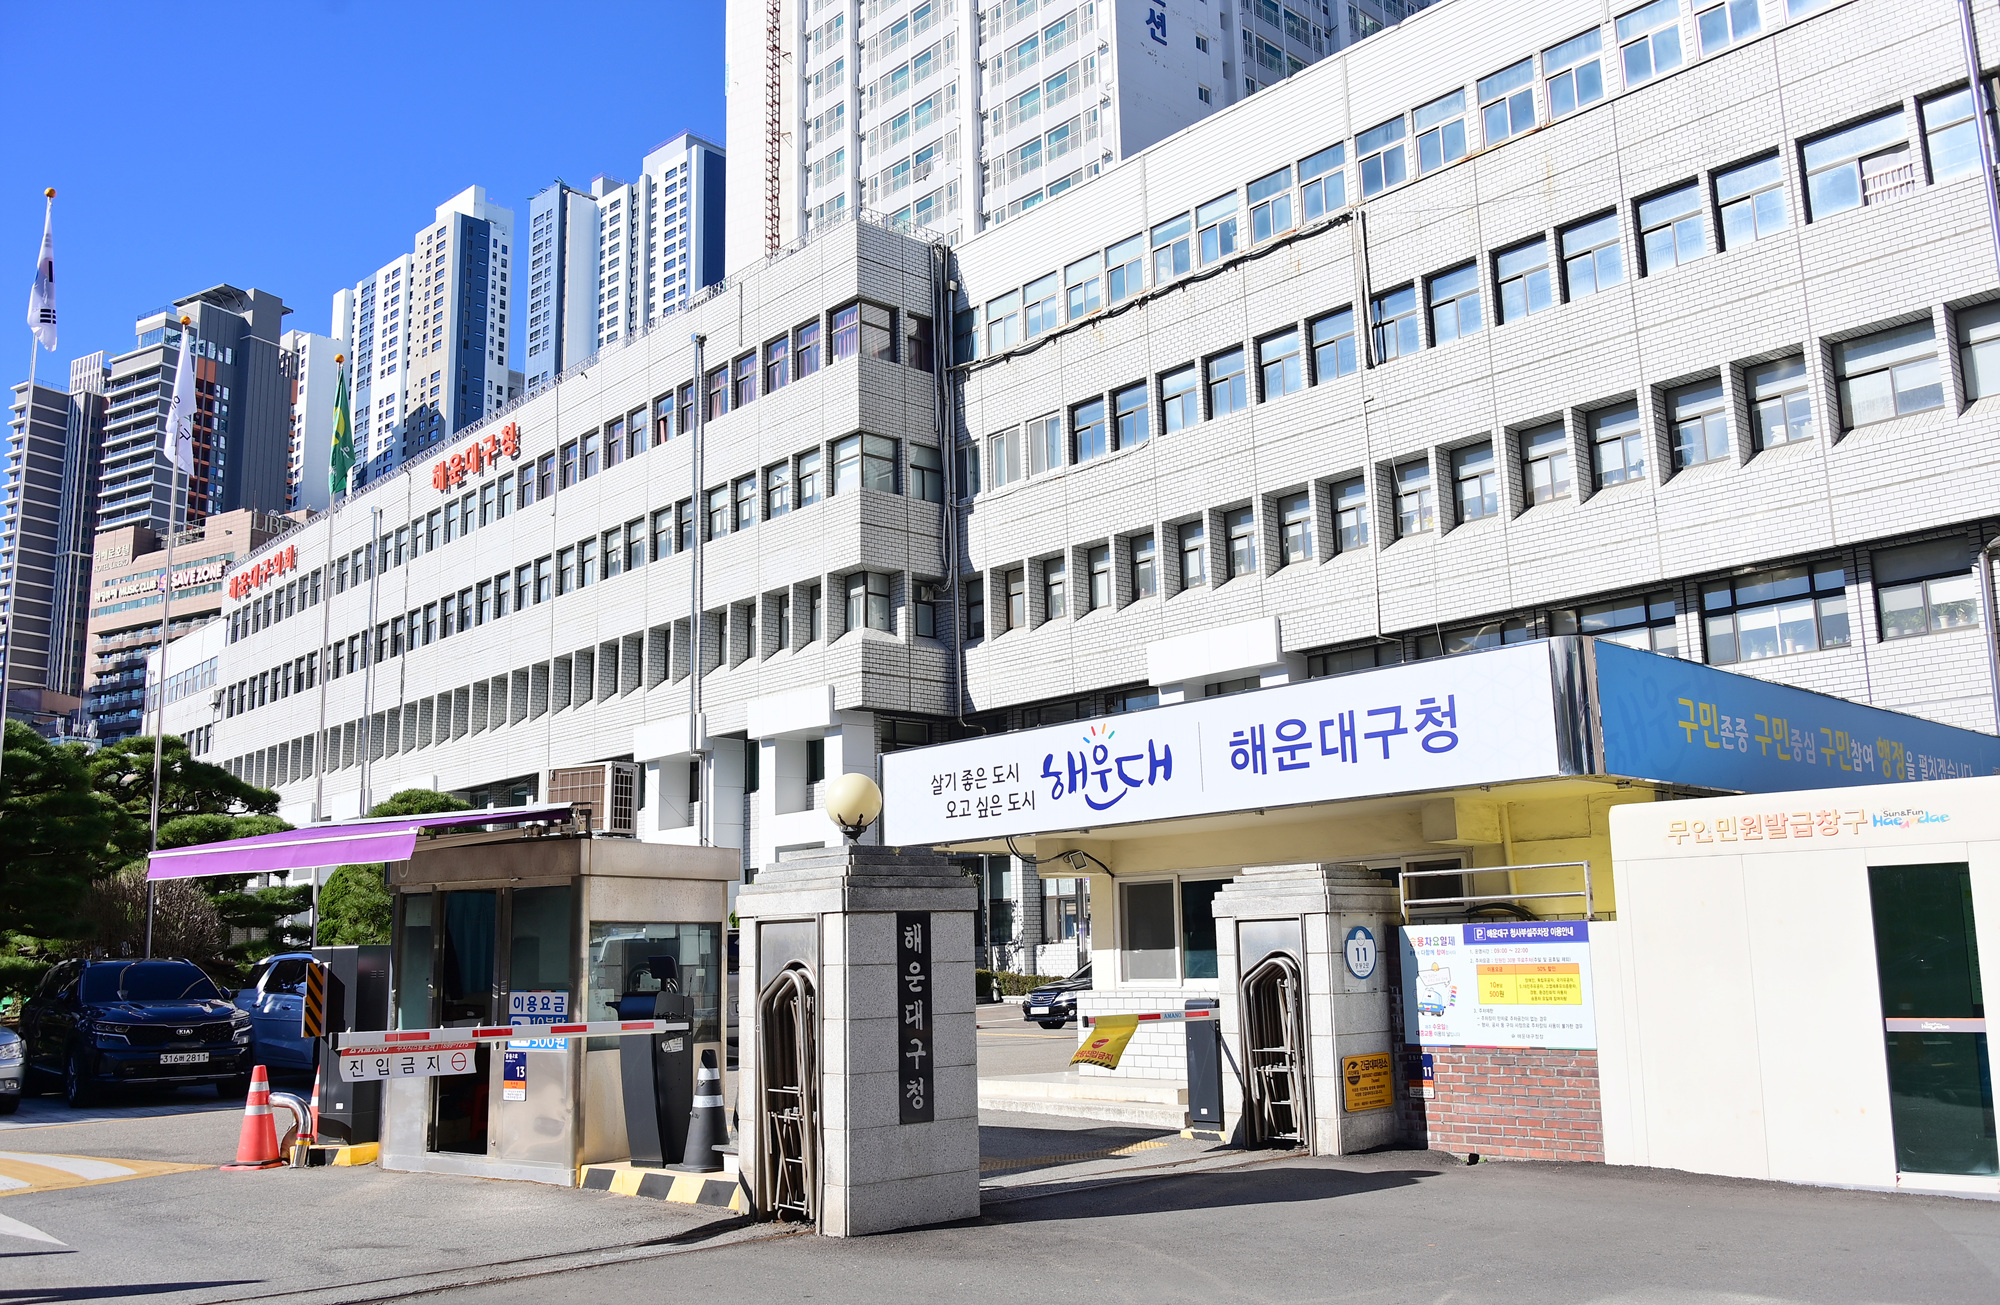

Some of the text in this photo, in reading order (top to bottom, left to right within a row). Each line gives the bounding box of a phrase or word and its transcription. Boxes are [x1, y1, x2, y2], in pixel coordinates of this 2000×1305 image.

[1145, 0, 1167, 46] 선
[432, 422, 516, 490] 해운대구청
[94, 543, 130, 562] 리베로호텔
[228, 544, 295, 599] 해운대구의회
[119, 582, 140, 597] MUSIC
[139, 579, 157, 592] CLUB
[1229, 694, 1459, 775] 해운대구청
[1678, 698, 1749, 753] 구민존중
[1754, 713, 1816, 764] 구민중심
[1820, 727, 1874, 772] 구민참여
[1876, 736, 1916, 781] 행정을
[931, 763, 1020, 795] 살기 좋은 도시
[1040, 739, 1172, 810] 해운대
[946, 790, 1035, 819] 오고 싶은 도시
[1883, 808, 1924, 818] Sun&Fun
[1666, 809, 1868, 845] 무인민원발급창구
[1487, 929, 1509, 939] 해운대구
[1510, 927, 1550, 938] 청사부설주차장
[1550, 926, 1574, 937] 이용안내
[1410, 936, 1456, 948] 승용차요일제
[1355, 947, 1367, 962] 11
[1489, 990, 1505, 998] 500원
[513, 995, 565, 1013] 이용요금
[904, 923, 926, 1110] 해운대구청
[186, 1053, 206, 1062] 2811
[1360, 1058, 1389, 1071] 긴급대피장소
[515, 1066, 525, 1078] 13
[1423, 1066, 1432, 1077] 11
